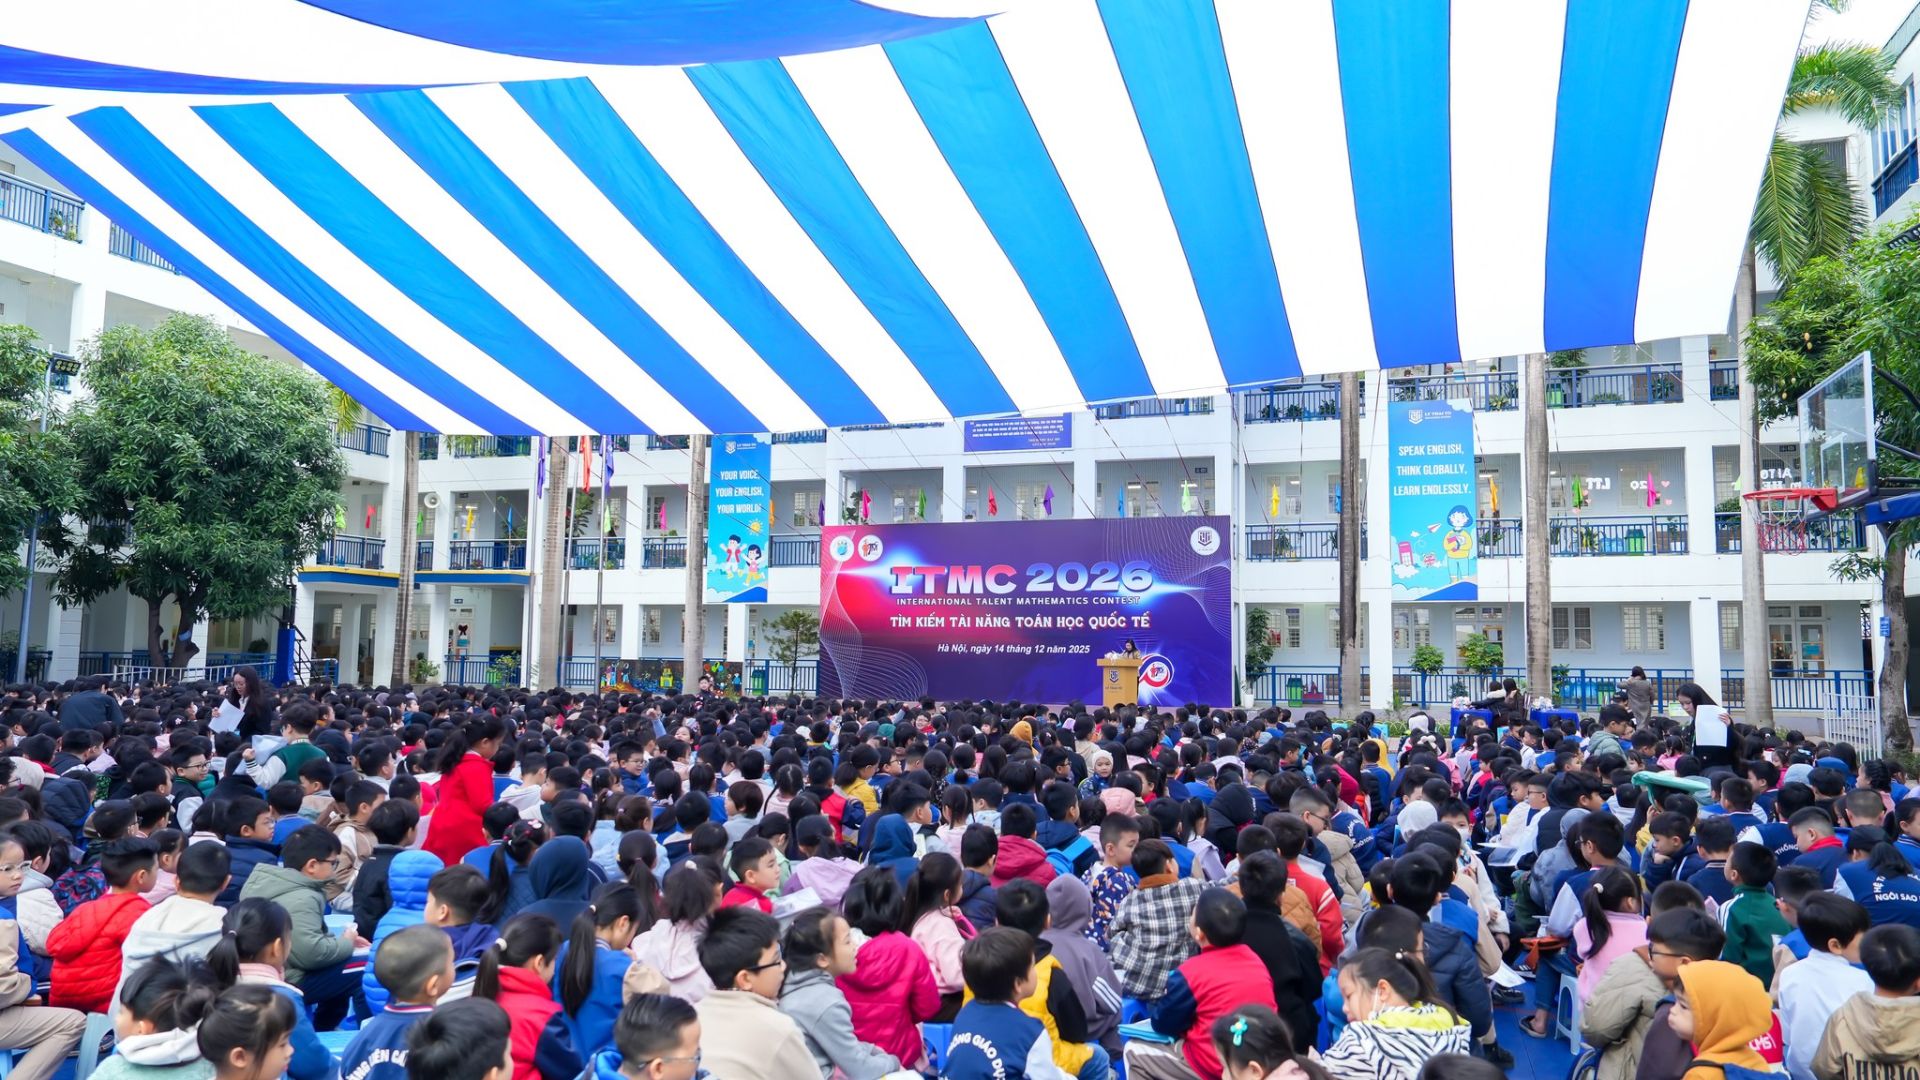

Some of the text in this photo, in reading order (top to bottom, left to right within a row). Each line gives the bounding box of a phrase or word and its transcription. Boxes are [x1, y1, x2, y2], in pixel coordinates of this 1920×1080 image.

[1398, 443, 1464, 456] SPEAK ENGLISH,
[720, 471, 738, 480] YOUR
[1396, 465, 1421, 476] THINK
[715, 487, 733, 497] YOUR
[1393, 483, 1472, 496] LEARN ENDLESSLY.
[717, 504, 735, 514] YOUR
[890, 560, 1153, 595] ITMC 2026
[897, 598, 972, 606] INTERNATIONAL
[1017, 597, 1088, 605] MATHEMATICS
[1092, 596, 1140, 605] CONTEST
[890, 611, 1150, 630] TÌM KIẾM TÀI NĂNG TOÁN HỌC QUỐC TẾ
[937, 643, 1090, 655] Hà Nội, ngày 14 tháng 12 năm 2025
[1875, 891, 1918, 902] NGÔI SAO
[992, 1058, 1006, 1080] DỤ
